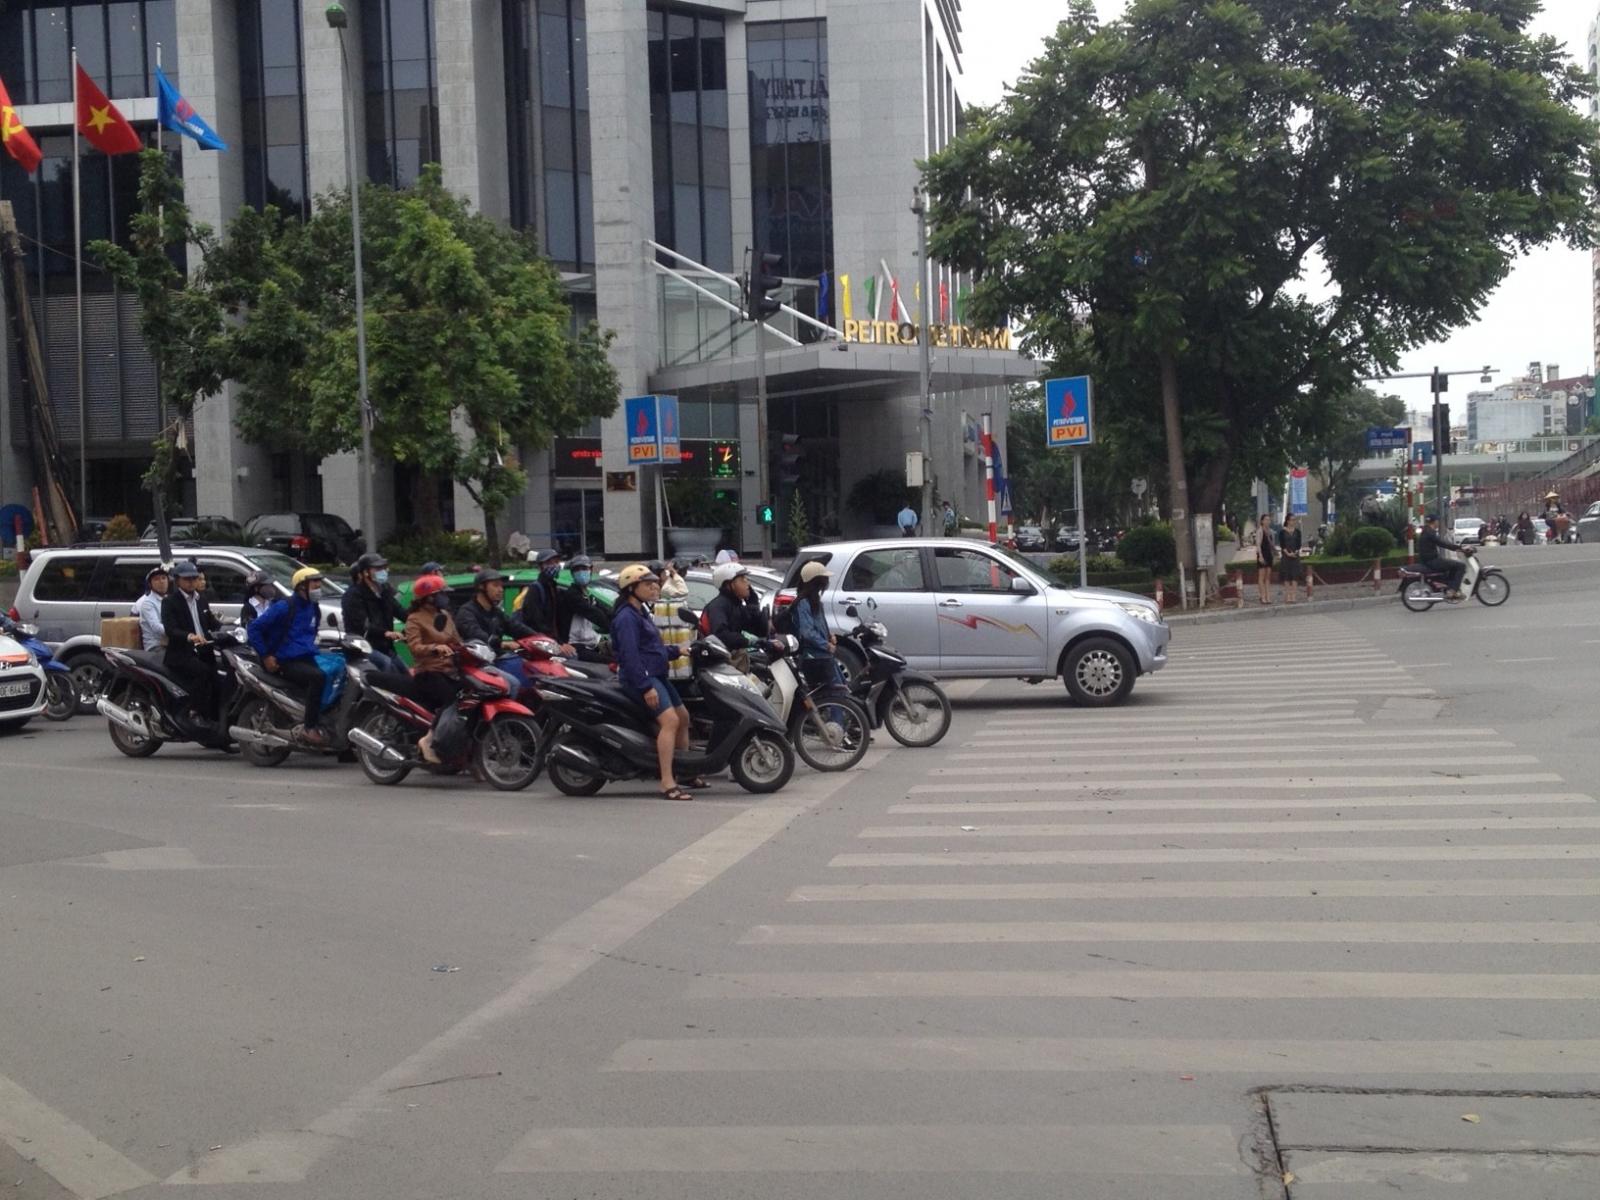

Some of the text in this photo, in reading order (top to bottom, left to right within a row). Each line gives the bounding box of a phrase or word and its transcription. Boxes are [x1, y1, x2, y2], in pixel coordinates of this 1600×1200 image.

[843, 319, 1011, 350] PETROIETNAM
[1056, 426, 1083, 439] PVI
[633, 446, 654, 457] PVI
